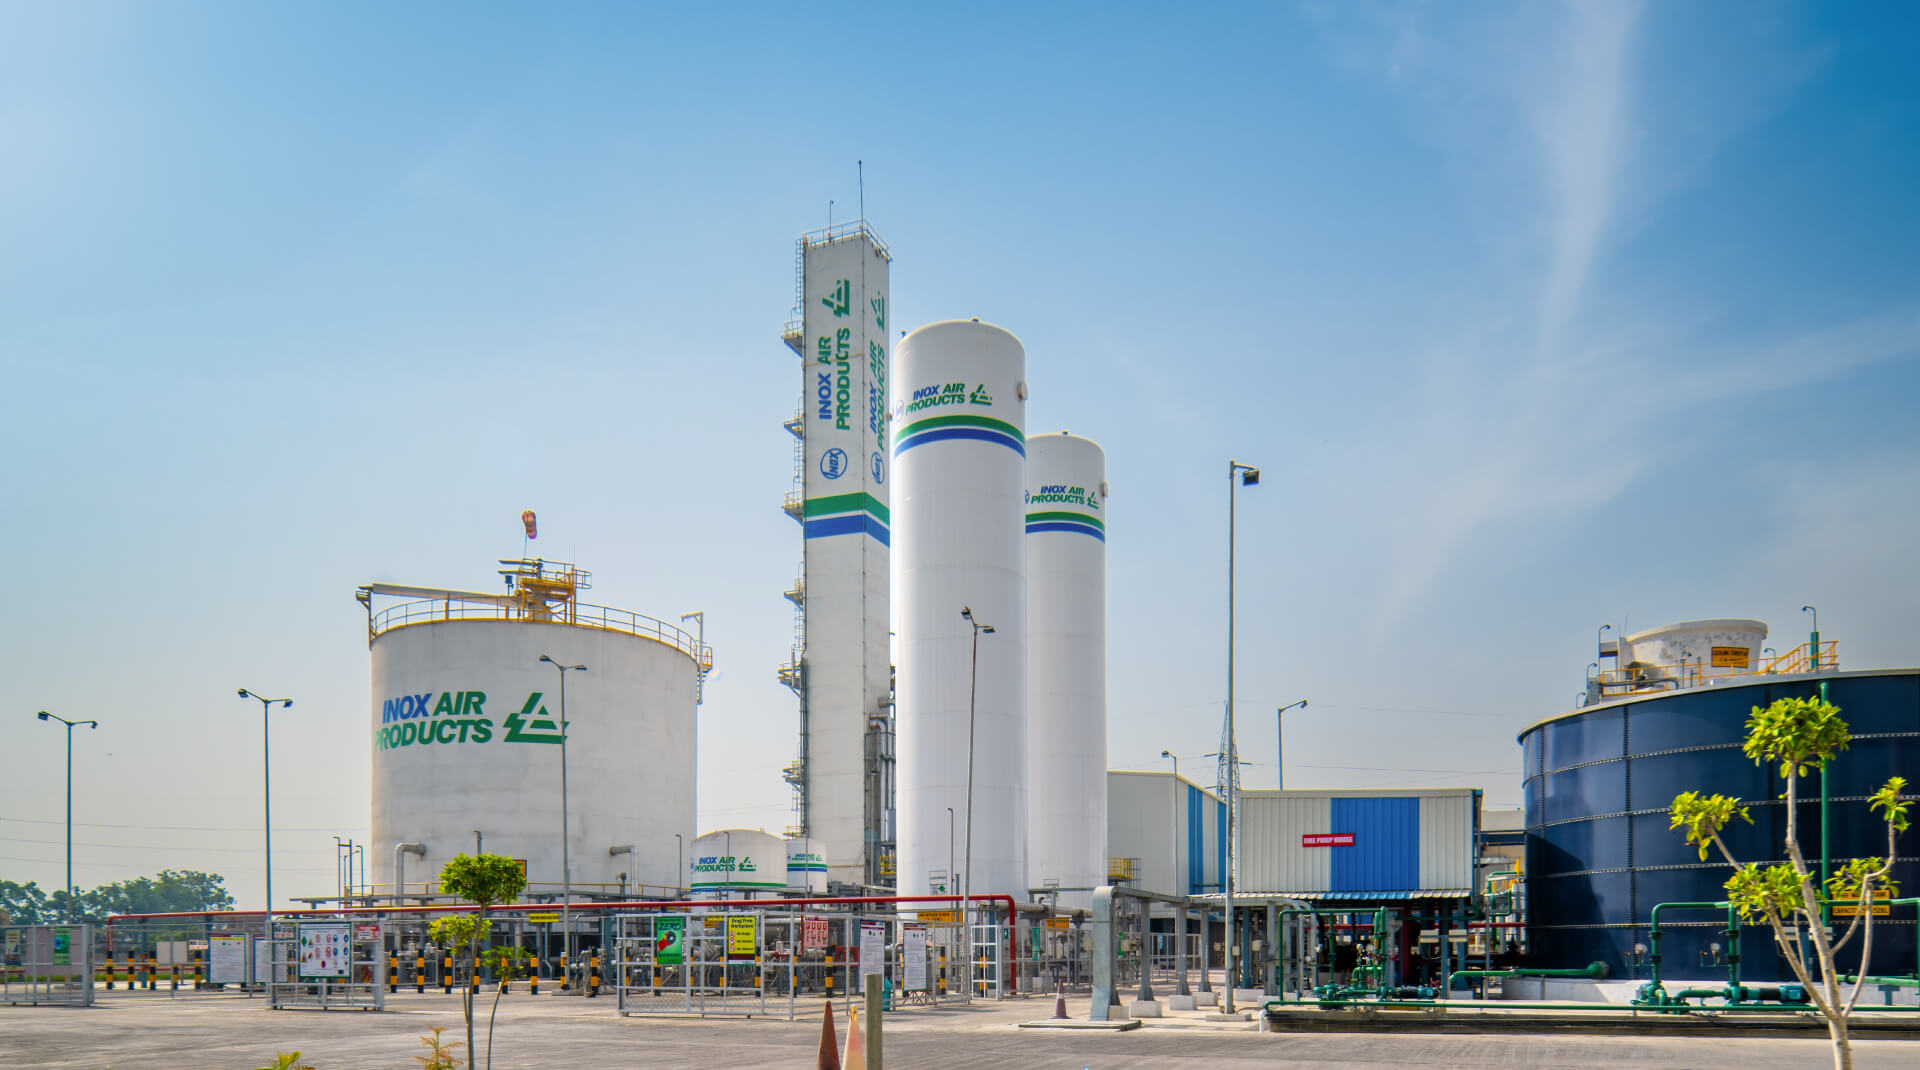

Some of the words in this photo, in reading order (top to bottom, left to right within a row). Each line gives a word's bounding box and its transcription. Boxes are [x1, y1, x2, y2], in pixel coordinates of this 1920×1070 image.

[817, 336, 831, 365] AIR
[869, 340, 877, 377] AIR
[836, 327, 850, 430] PRODUCTS
[912, 384, 940, 401] INOX
[943, 383, 965, 394] AIR
[818, 373, 832, 420] INOX
[869, 381, 877, 435] INOX
[877, 343, 885, 452] PRODUCTS
[905, 393, 965, 416] PRODUCTS
[1030, 494, 1085, 505] PRODUCTS
[1040, 485, 1067, 494] INOX
[1068, 486, 1085, 496] AIR
[382, 693, 432, 724] INOX
[432, 691, 487, 716] AIR
[375, 718, 494, 751] PRODUCTS
[695, 864, 735, 872] PRODUCTS
